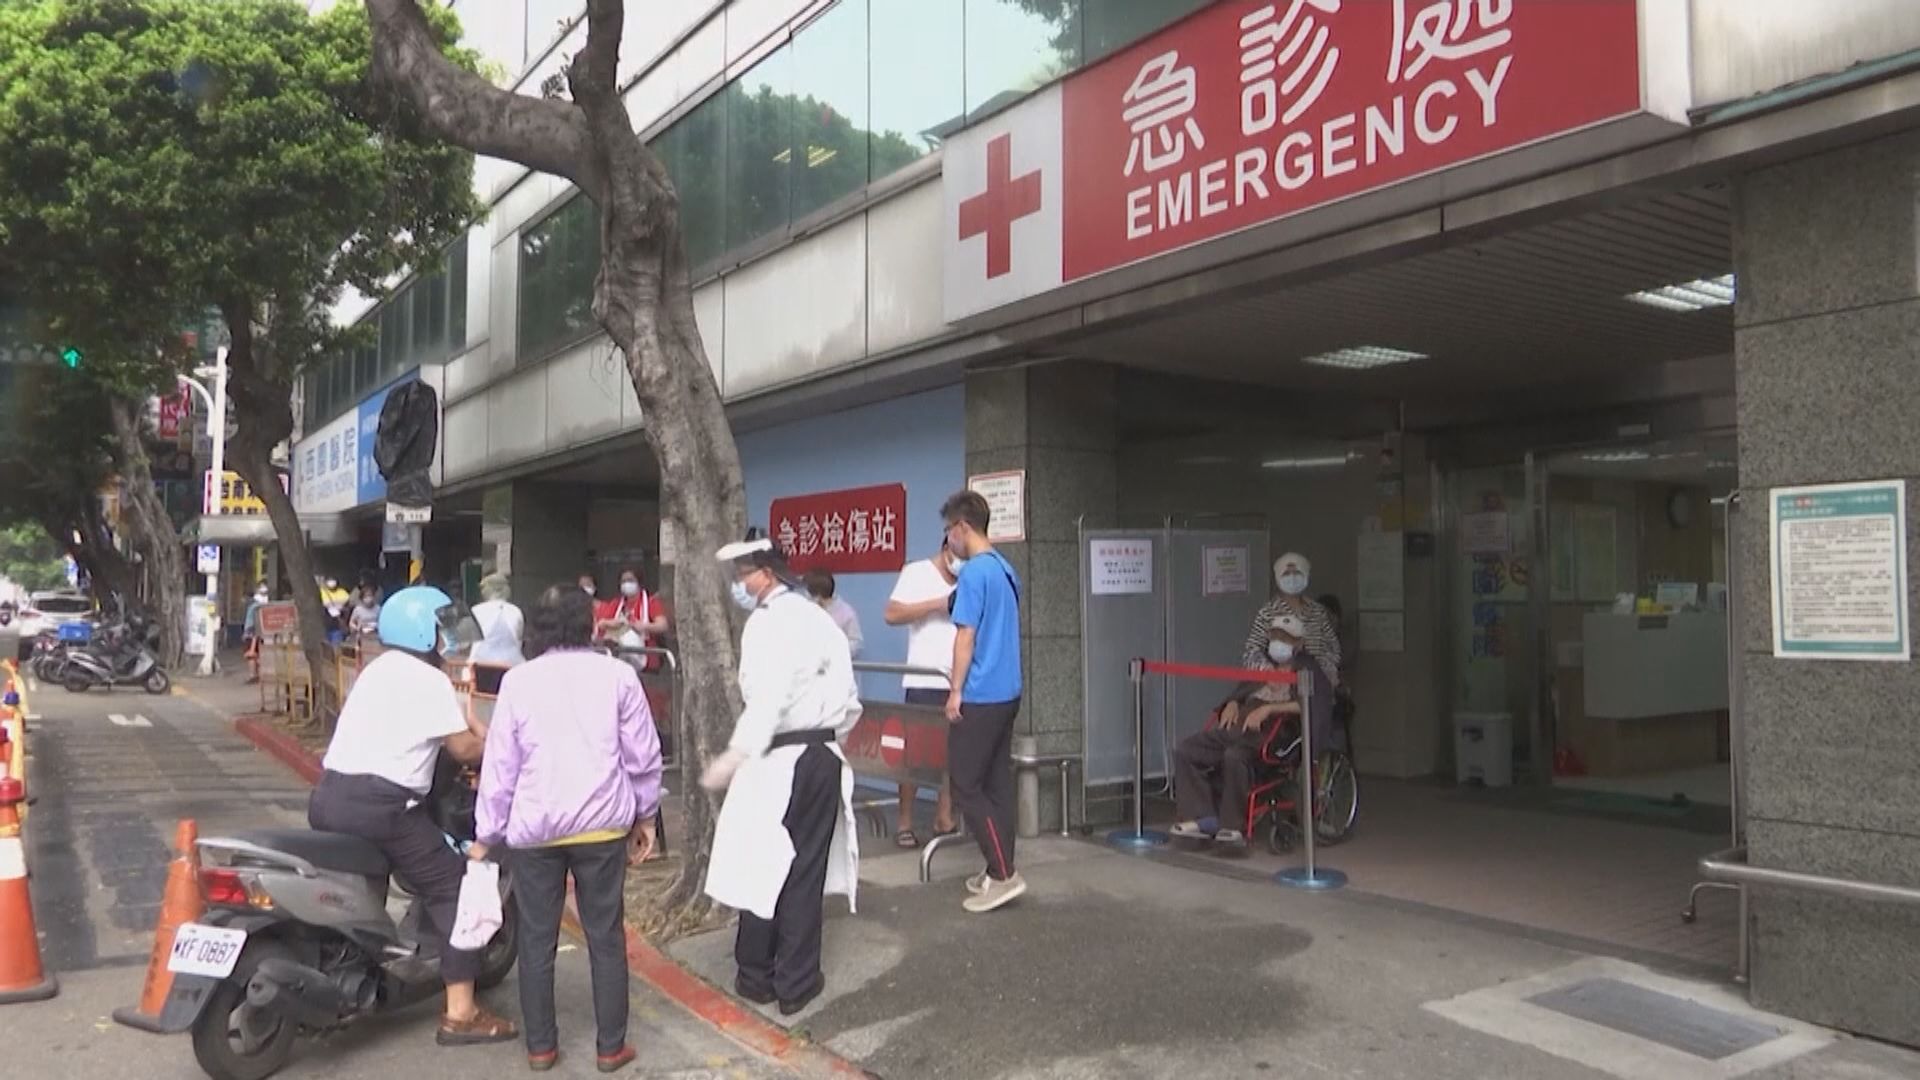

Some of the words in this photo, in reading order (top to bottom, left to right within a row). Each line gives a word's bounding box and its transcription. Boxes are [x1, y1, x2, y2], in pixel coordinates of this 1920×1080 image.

[1126, 55, 1515, 241] EMERGENCY
[778, 506, 896, 556] 急診檢傷站
